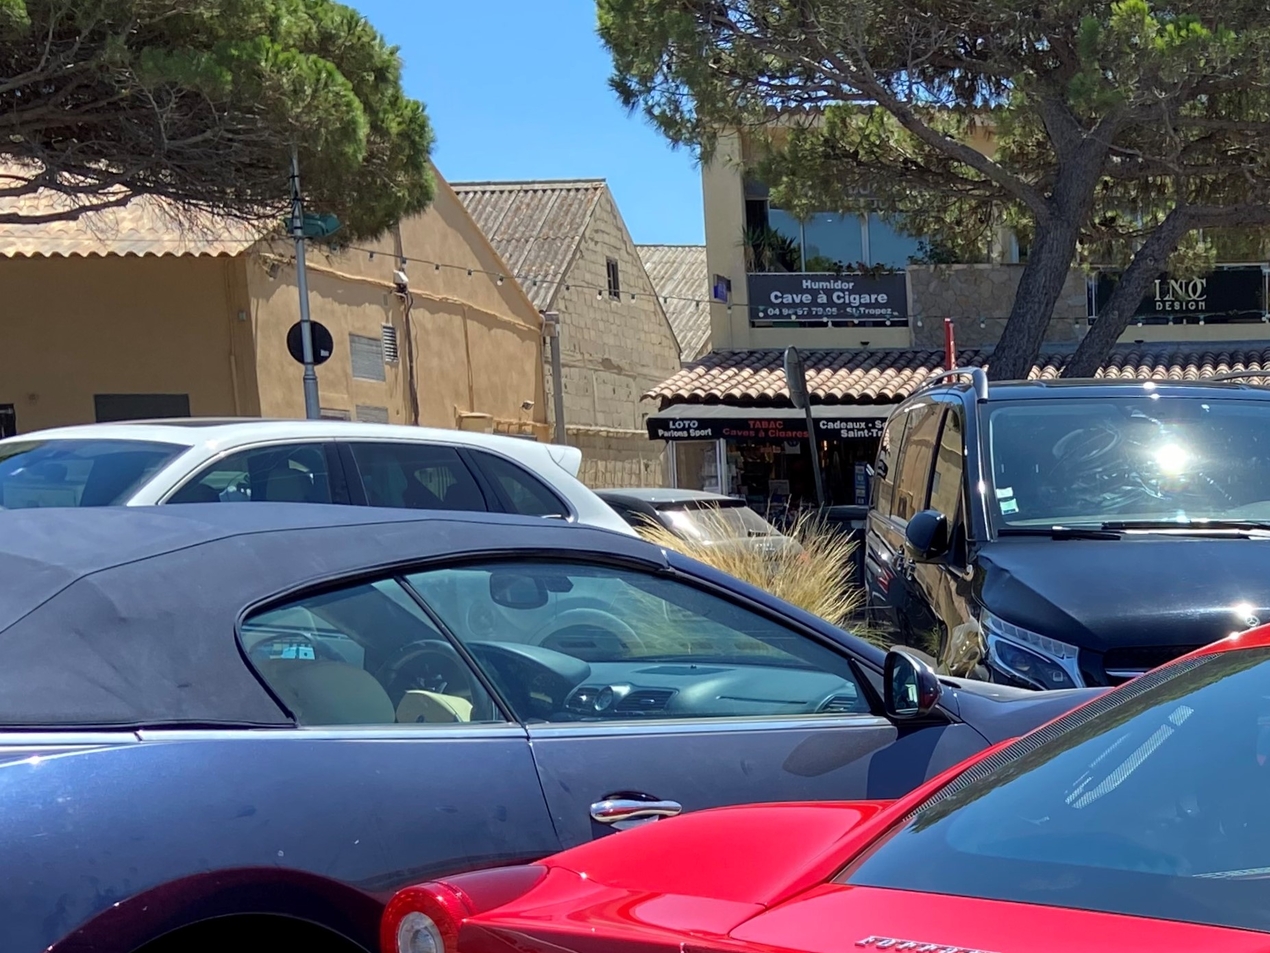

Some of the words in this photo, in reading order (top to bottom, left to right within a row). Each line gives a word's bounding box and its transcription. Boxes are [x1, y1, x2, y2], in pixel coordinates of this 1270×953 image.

[802, 280, 854, 289] Humidor
[770, 291, 812, 304] Cave
[817, 290, 828, 304] à
[832, 291, 888, 306] Cigare
[1156, 302, 1206, 310] DESIGN
[670, 420, 698, 429] LOTO
[748, 420, 784, 429] TABAC
[820, 420, 866, 430] Cadeaux
[658, 428, 688, 438] Parions
[690, 428, 712, 438] Sport
